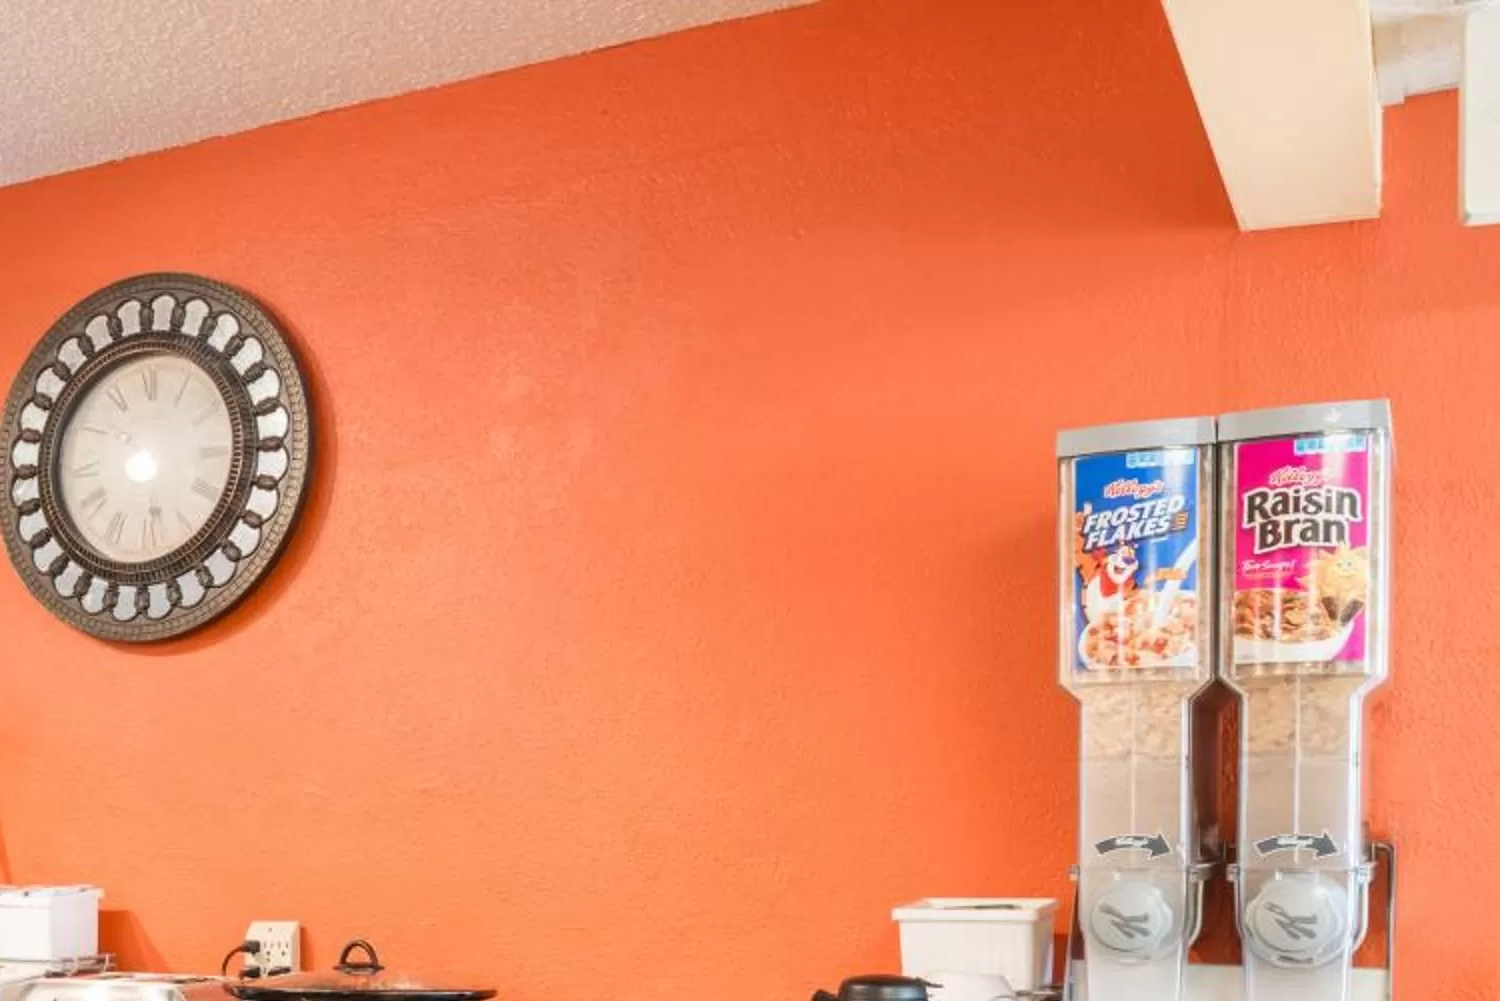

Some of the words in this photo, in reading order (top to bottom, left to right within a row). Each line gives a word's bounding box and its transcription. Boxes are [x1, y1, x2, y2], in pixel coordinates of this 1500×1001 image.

[1084, 494, 1185, 534] FROSTED
[1244, 487, 1361, 525] Raisin
[1085, 514, 1172, 550] FLAKES
[1257, 518, 1347, 552] Bran
